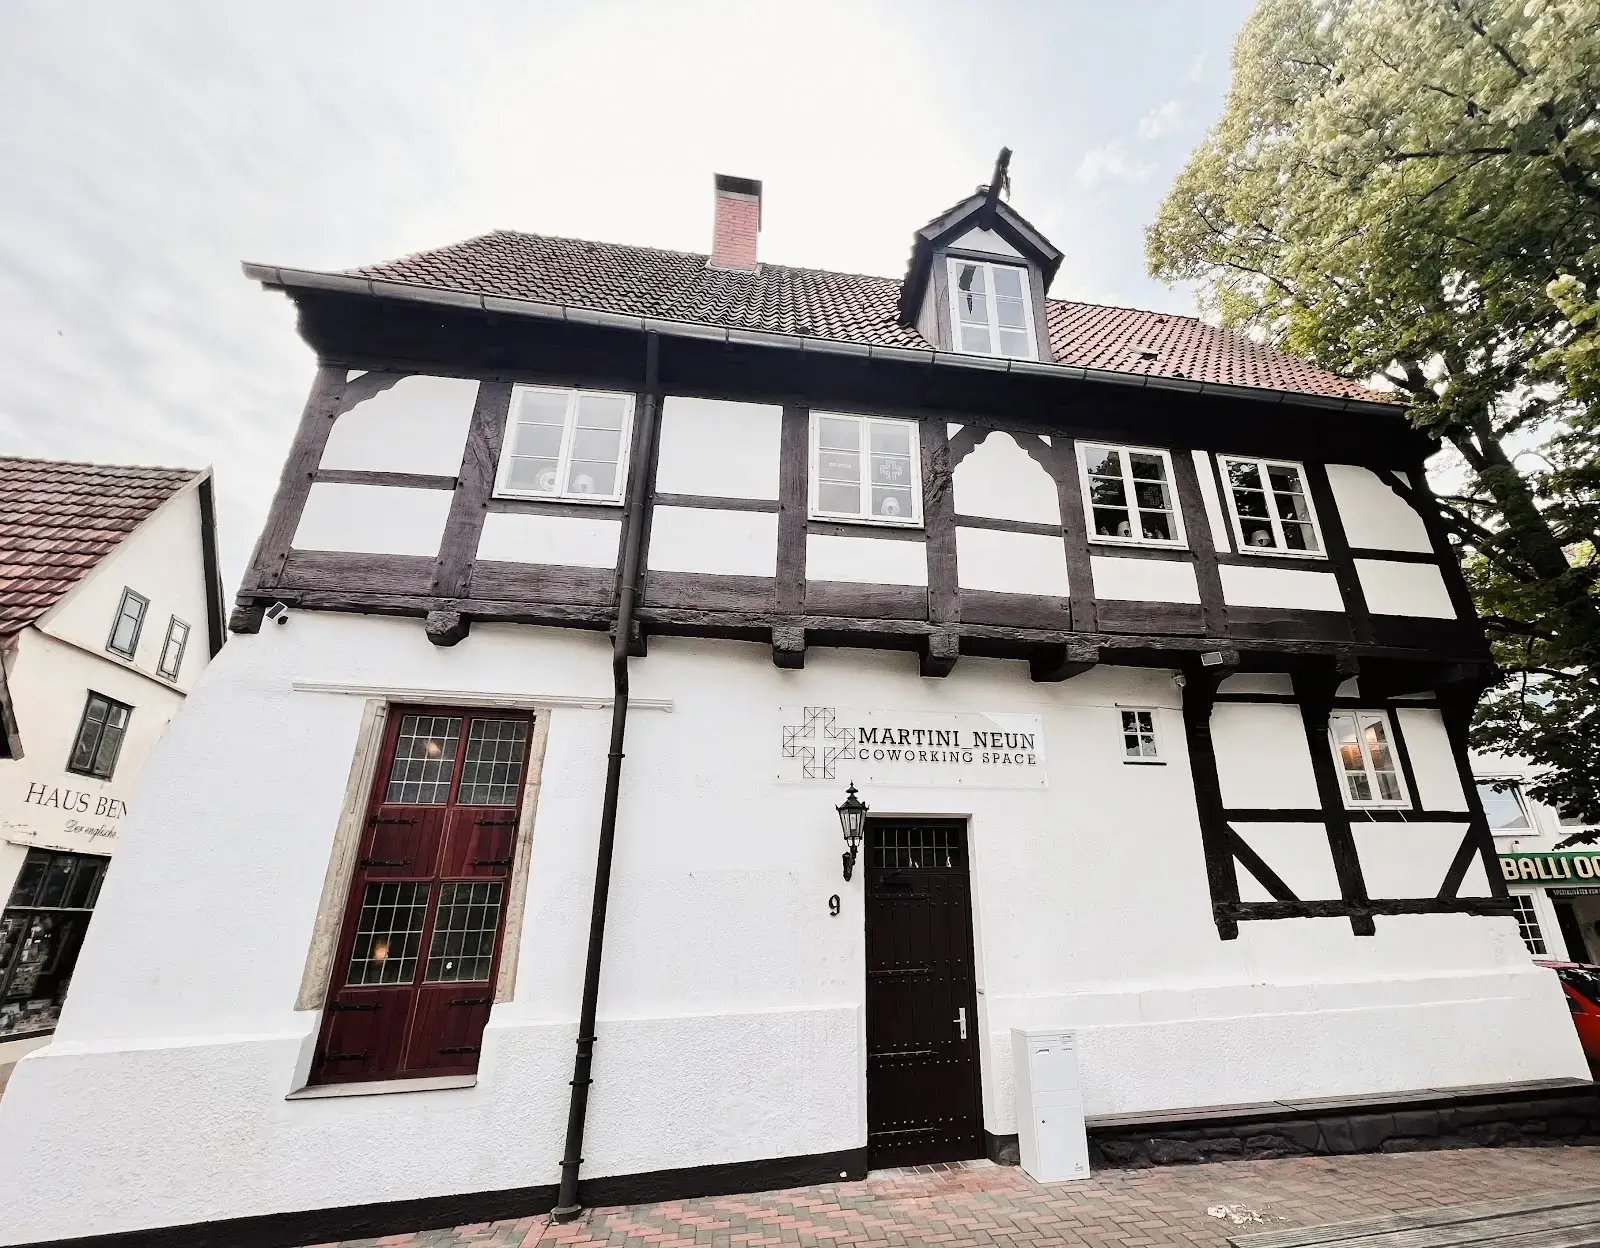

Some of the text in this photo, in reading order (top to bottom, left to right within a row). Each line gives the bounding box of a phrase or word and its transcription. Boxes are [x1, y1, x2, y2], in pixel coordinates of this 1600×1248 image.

[859, 727, 1035, 750] MARTINI_NEUN
[859, 748, 1037, 765] COWORKING SPACE
[24, 781, 91, 813] HAUS
[64, 819, 84, 834] Der
[1499, 856, 1572, 881] BALLI
[828, 893, 841, 917] 9
